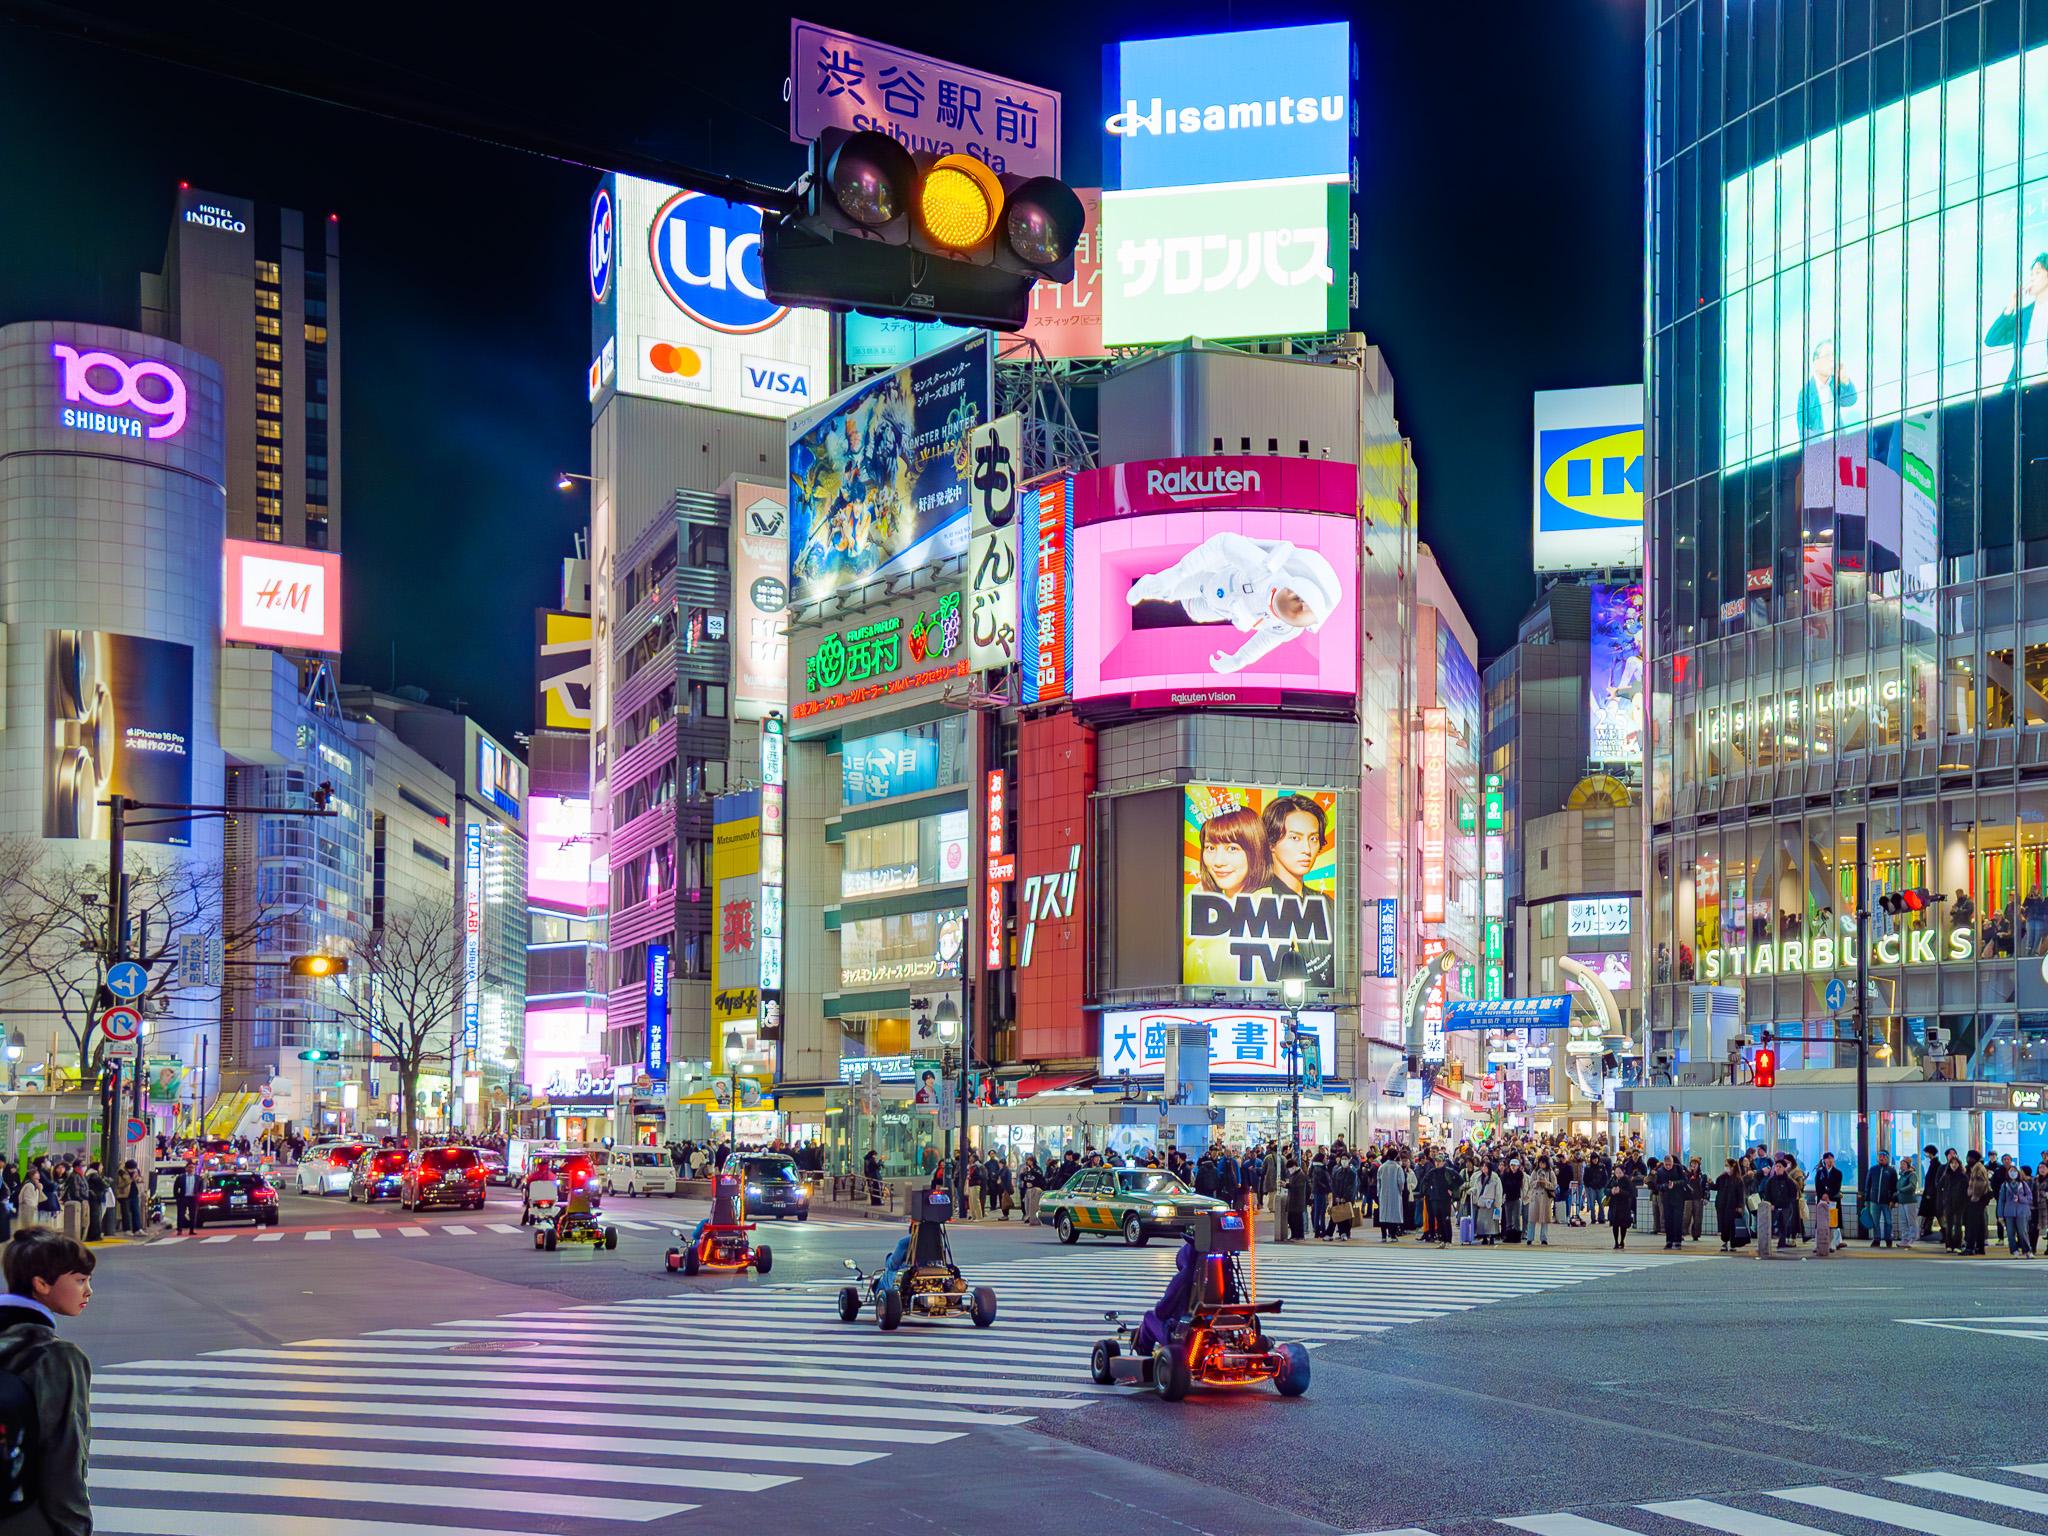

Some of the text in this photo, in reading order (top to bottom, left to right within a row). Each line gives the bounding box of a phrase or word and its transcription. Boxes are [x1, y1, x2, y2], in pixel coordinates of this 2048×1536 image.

[816, 46, 1039, 149] 渋谷駅前
[1105, 95, 1344, 137] Hisamitsu
[185, 210, 246, 234] INDIGO
[200, 204, 233, 218] HOTEL
[1116, 227, 1334, 297] サロンパス
[1034, 315, 1080, 327] スティック
[54, 344, 187, 439] 109
[651, 374, 700, 388] mastercard
[748, 366, 808, 397] VISA
[914, 362, 971, 392] モンスターハンター
[917, 379, 966, 407] シリーズ最新作
[64, 409, 142, 438] SHIBUYA
[942, 415, 977, 437] HUNTER
[918, 485, 963, 512] 好評発売中
[1147, 466, 1261, 501] Rakuten
[973, 427, 1016, 658] もんじゃ
[256, 577, 312, 615] H&M
[847, 633, 899, 681] 西村
[1171, 692, 1236, 703] Rakuten Vision
[134, 728, 162, 741] iPhone
[172, 734, 185, 743] Pro
[1189, 893, 1330, 942] DMM
[1571, 917, 1629, 933] クリニック
[1585, 903, 1629, 917] れいわ
[1381, 903, 1394, 974] 大盛堂商事ビル
[653, 955, 664, 997] MIZUHO
[1229, 943, 1292, 983] TV
[1994, 1119, 2047, 1135] Galaxy
